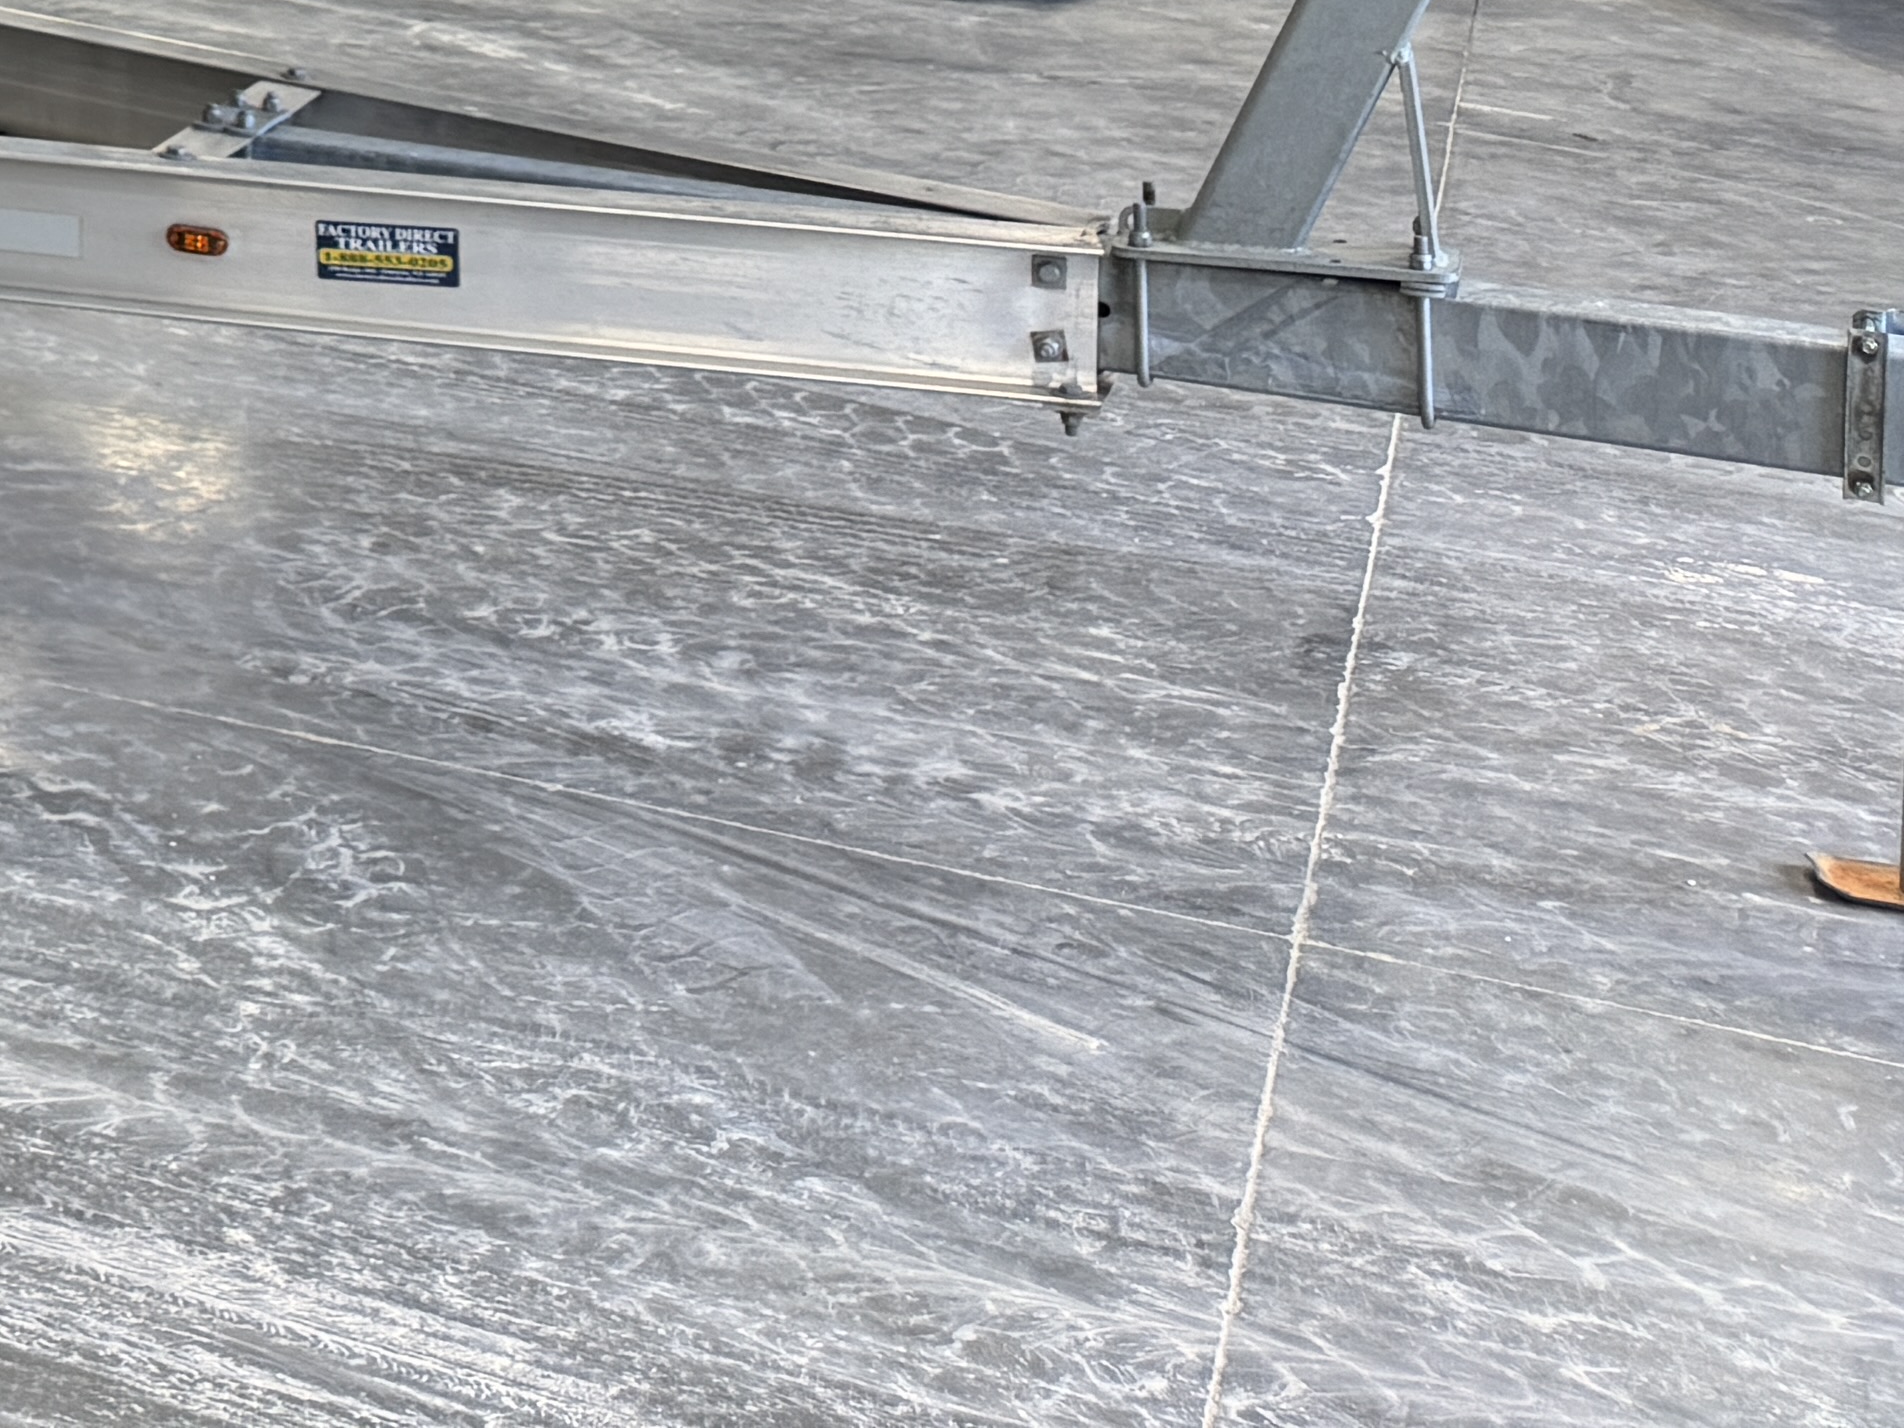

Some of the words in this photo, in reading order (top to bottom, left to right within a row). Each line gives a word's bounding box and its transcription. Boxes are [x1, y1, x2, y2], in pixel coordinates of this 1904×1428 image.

[317, 223, 392, 240] FACTORY
[395, 228, 456, 244] DIRECT
[335, 237, 439, 254] TRAILERS
